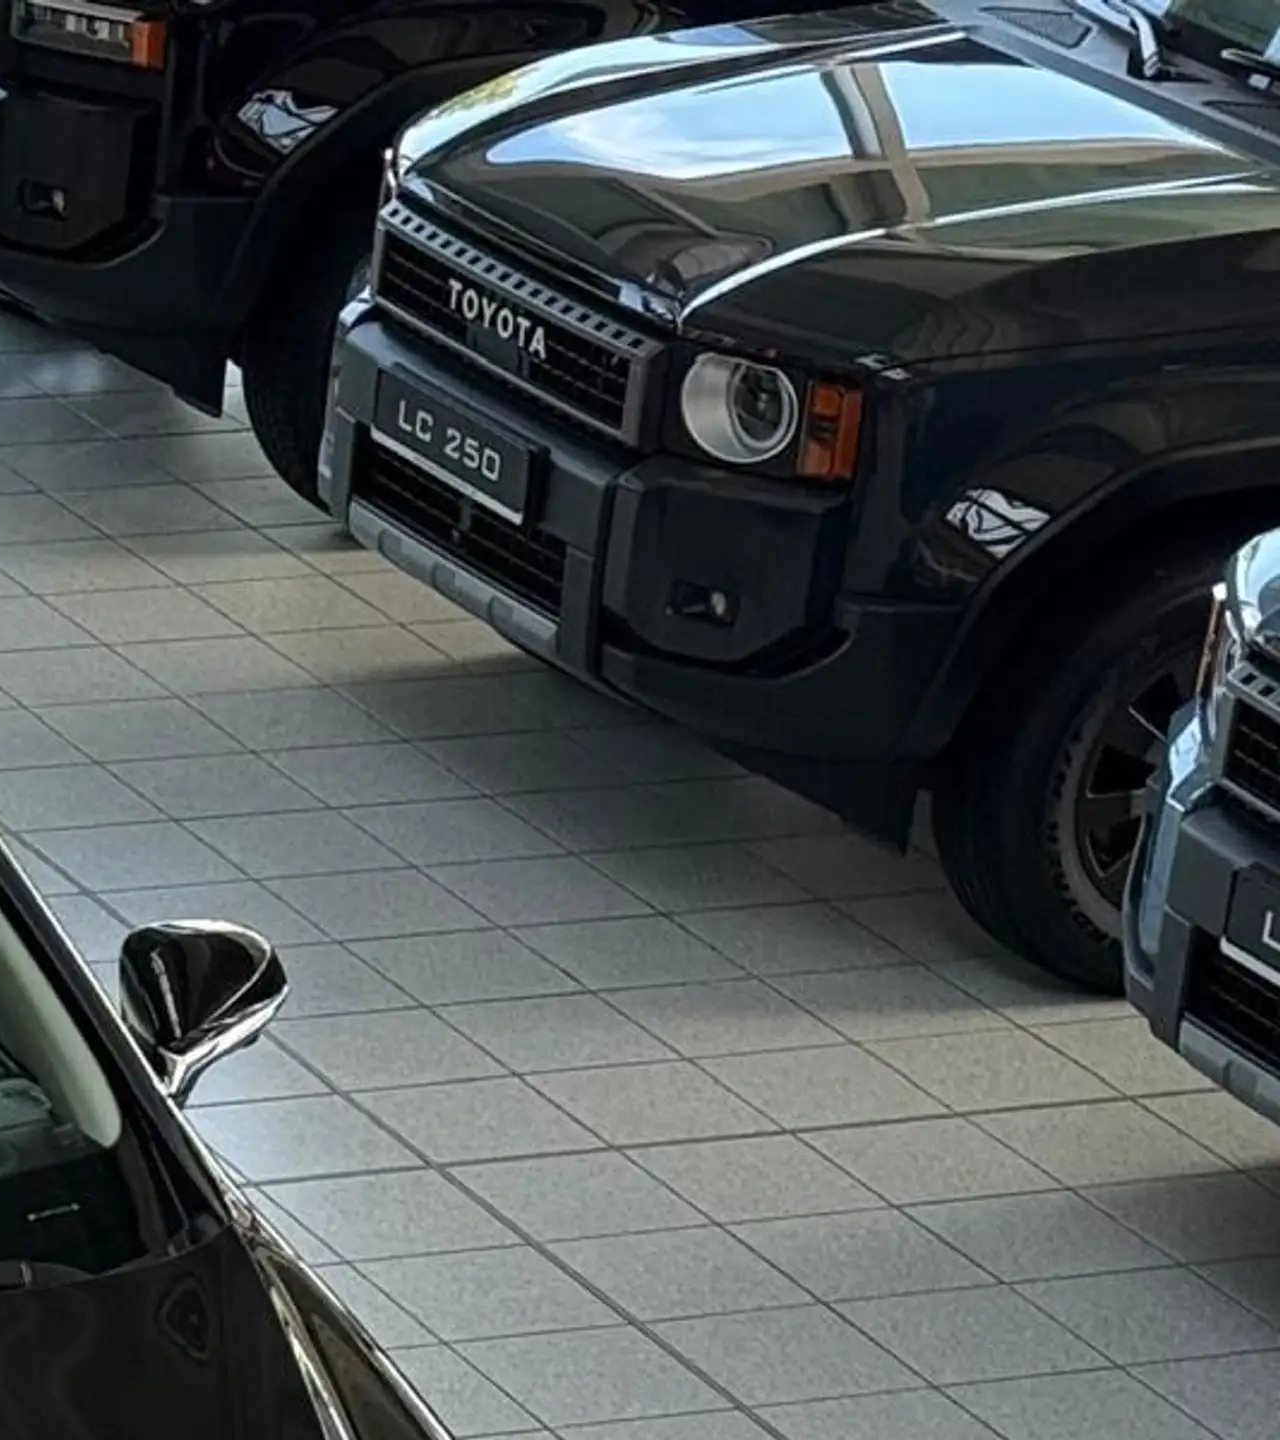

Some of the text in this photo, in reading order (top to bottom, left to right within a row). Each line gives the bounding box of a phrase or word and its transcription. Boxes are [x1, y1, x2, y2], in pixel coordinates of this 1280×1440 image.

[448, 279, 546, 359] TOYOTA
[398, 400, 501, 481] LC 250
